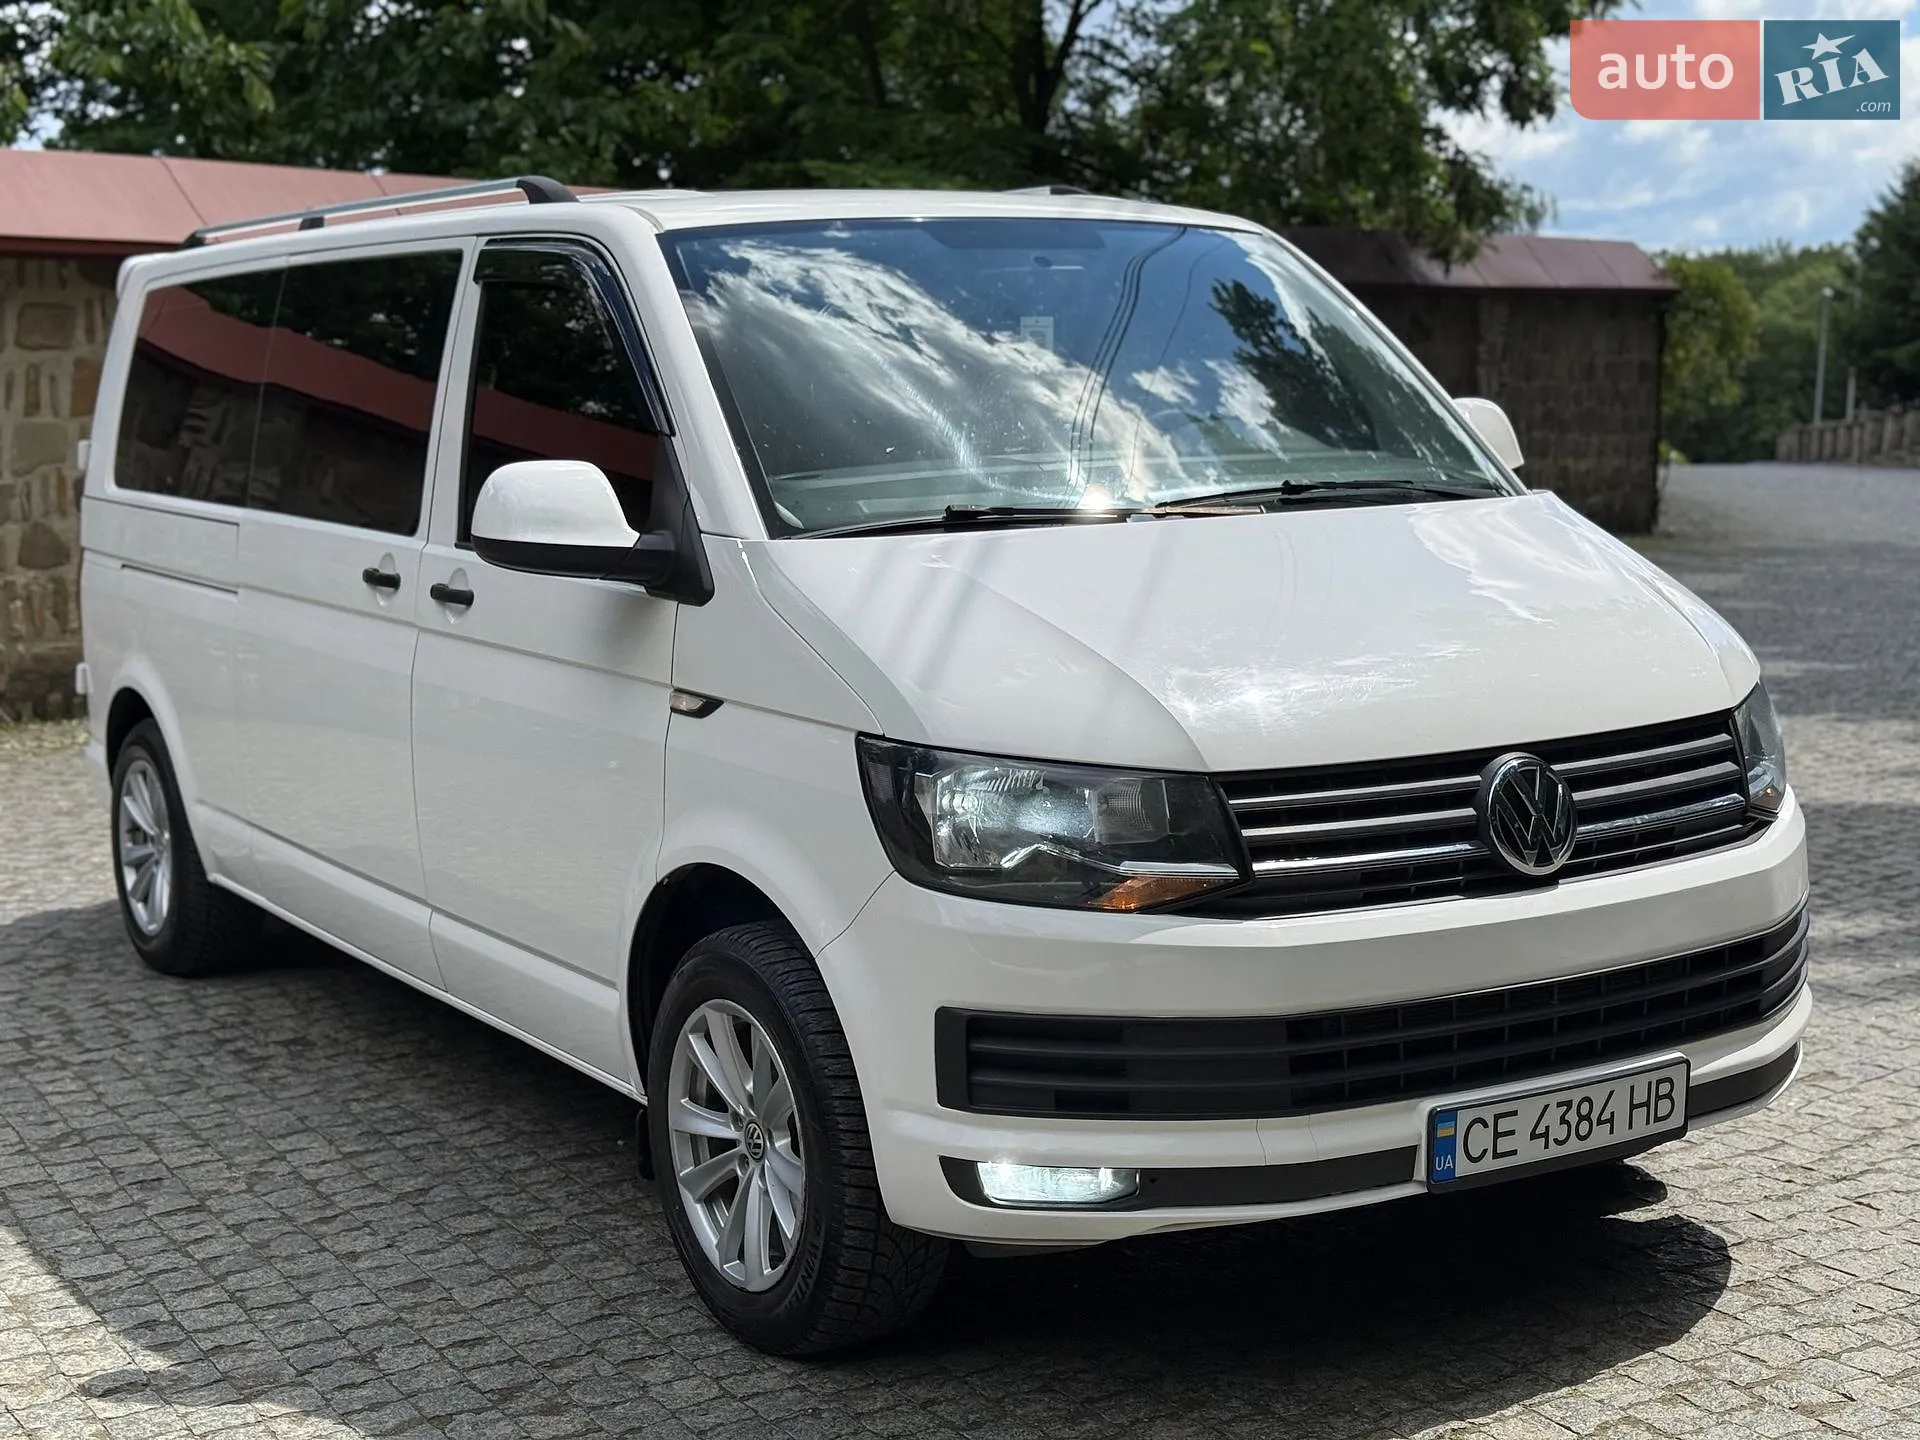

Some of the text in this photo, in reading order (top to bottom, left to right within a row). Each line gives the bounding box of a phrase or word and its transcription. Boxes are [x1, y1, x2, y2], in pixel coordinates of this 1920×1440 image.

[1462, 1076, 1676, 1163] CE 4384 HB
[1435, 1155, 1454, 1171] UA
